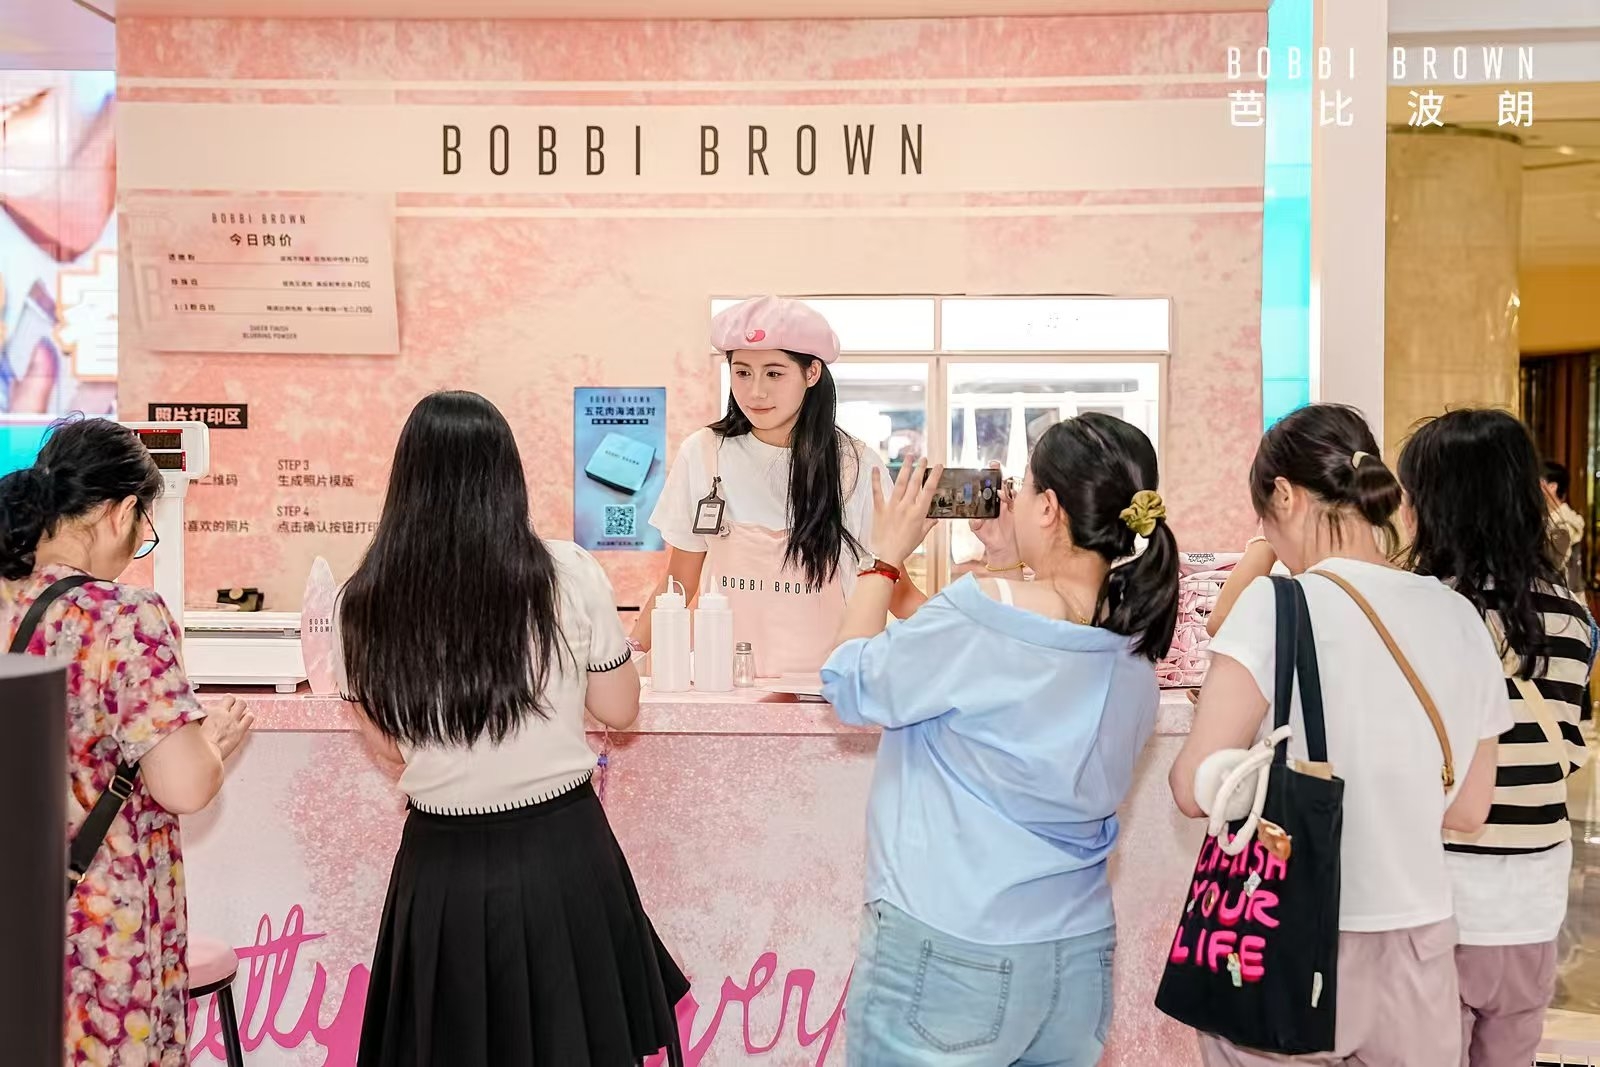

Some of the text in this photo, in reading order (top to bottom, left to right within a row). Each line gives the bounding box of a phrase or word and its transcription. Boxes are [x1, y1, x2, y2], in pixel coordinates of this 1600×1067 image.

[442, 123, 923, 176] BOBBI BROWN
[211, 212, 306, 225] BOBBI BROWN
[229, 233, 292, 247] 今日肉价
[155, 407, 241, 424] 照片打印区
[278, 459, 310, 471] STEP 3
[278, 474, 354, 487] 生成照片模版
[277, 505, 310, 517] STEP 4
[184, 520, 249, 533] 喜欢的照片
[722, 575, 763, 591] BOBBI
[309, 618, 329, 626] BOBB
[1187, 878, 1280, 928] YOUR
[1170, 924, 1267, 983] LIFE
